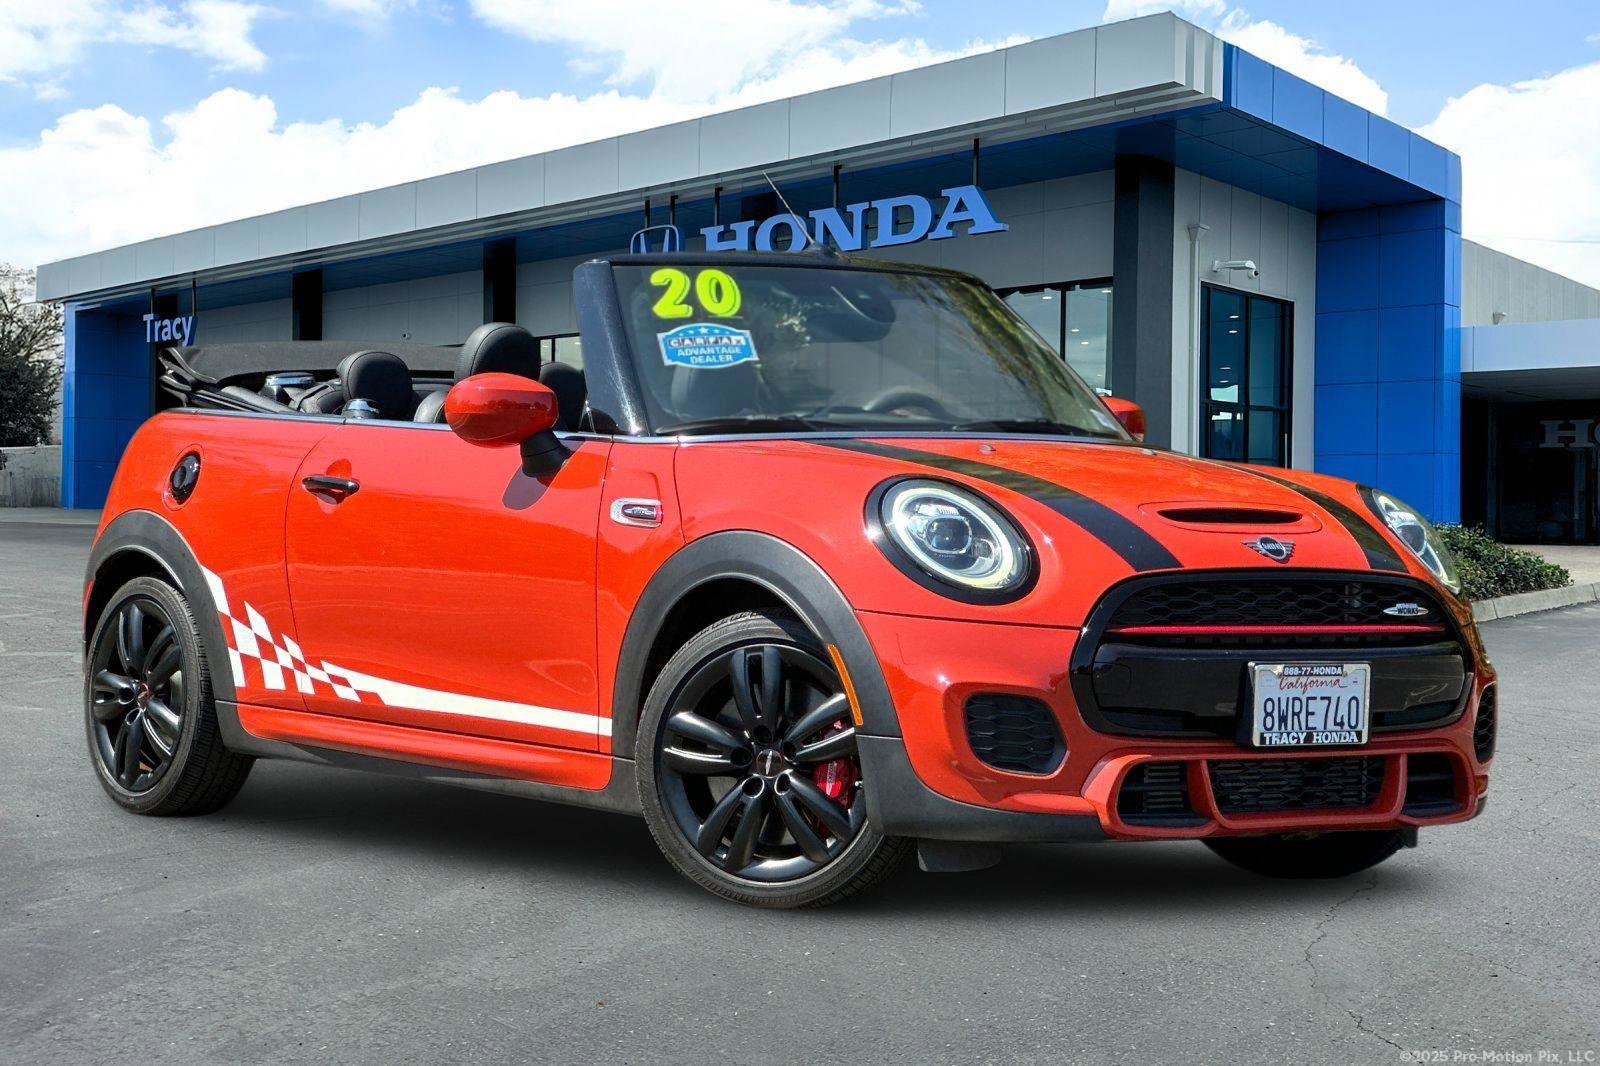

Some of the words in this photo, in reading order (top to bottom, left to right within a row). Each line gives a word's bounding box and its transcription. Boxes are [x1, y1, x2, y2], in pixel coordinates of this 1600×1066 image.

[700, 184, 1010, 253] HONDA
[650, 268, 742, 319] 20
[143, 313, 193, 348] Tracy
[669, 336, 746, 348] CARFAX
[677, 346, 742, 357] ADVANTAGE
[689, 354, 734, 364] DEALER
[1539, 419, 1600, 448] H
[1283, 666, 1343, 675] 888-77-HONDA
[1279, 677, 1348, 694] California
[1262, 696, 1360, 731] 8WRE740
[1263, 732, 1306, 745] TRACY
[1312, 731, 1360, 744] HONDA
